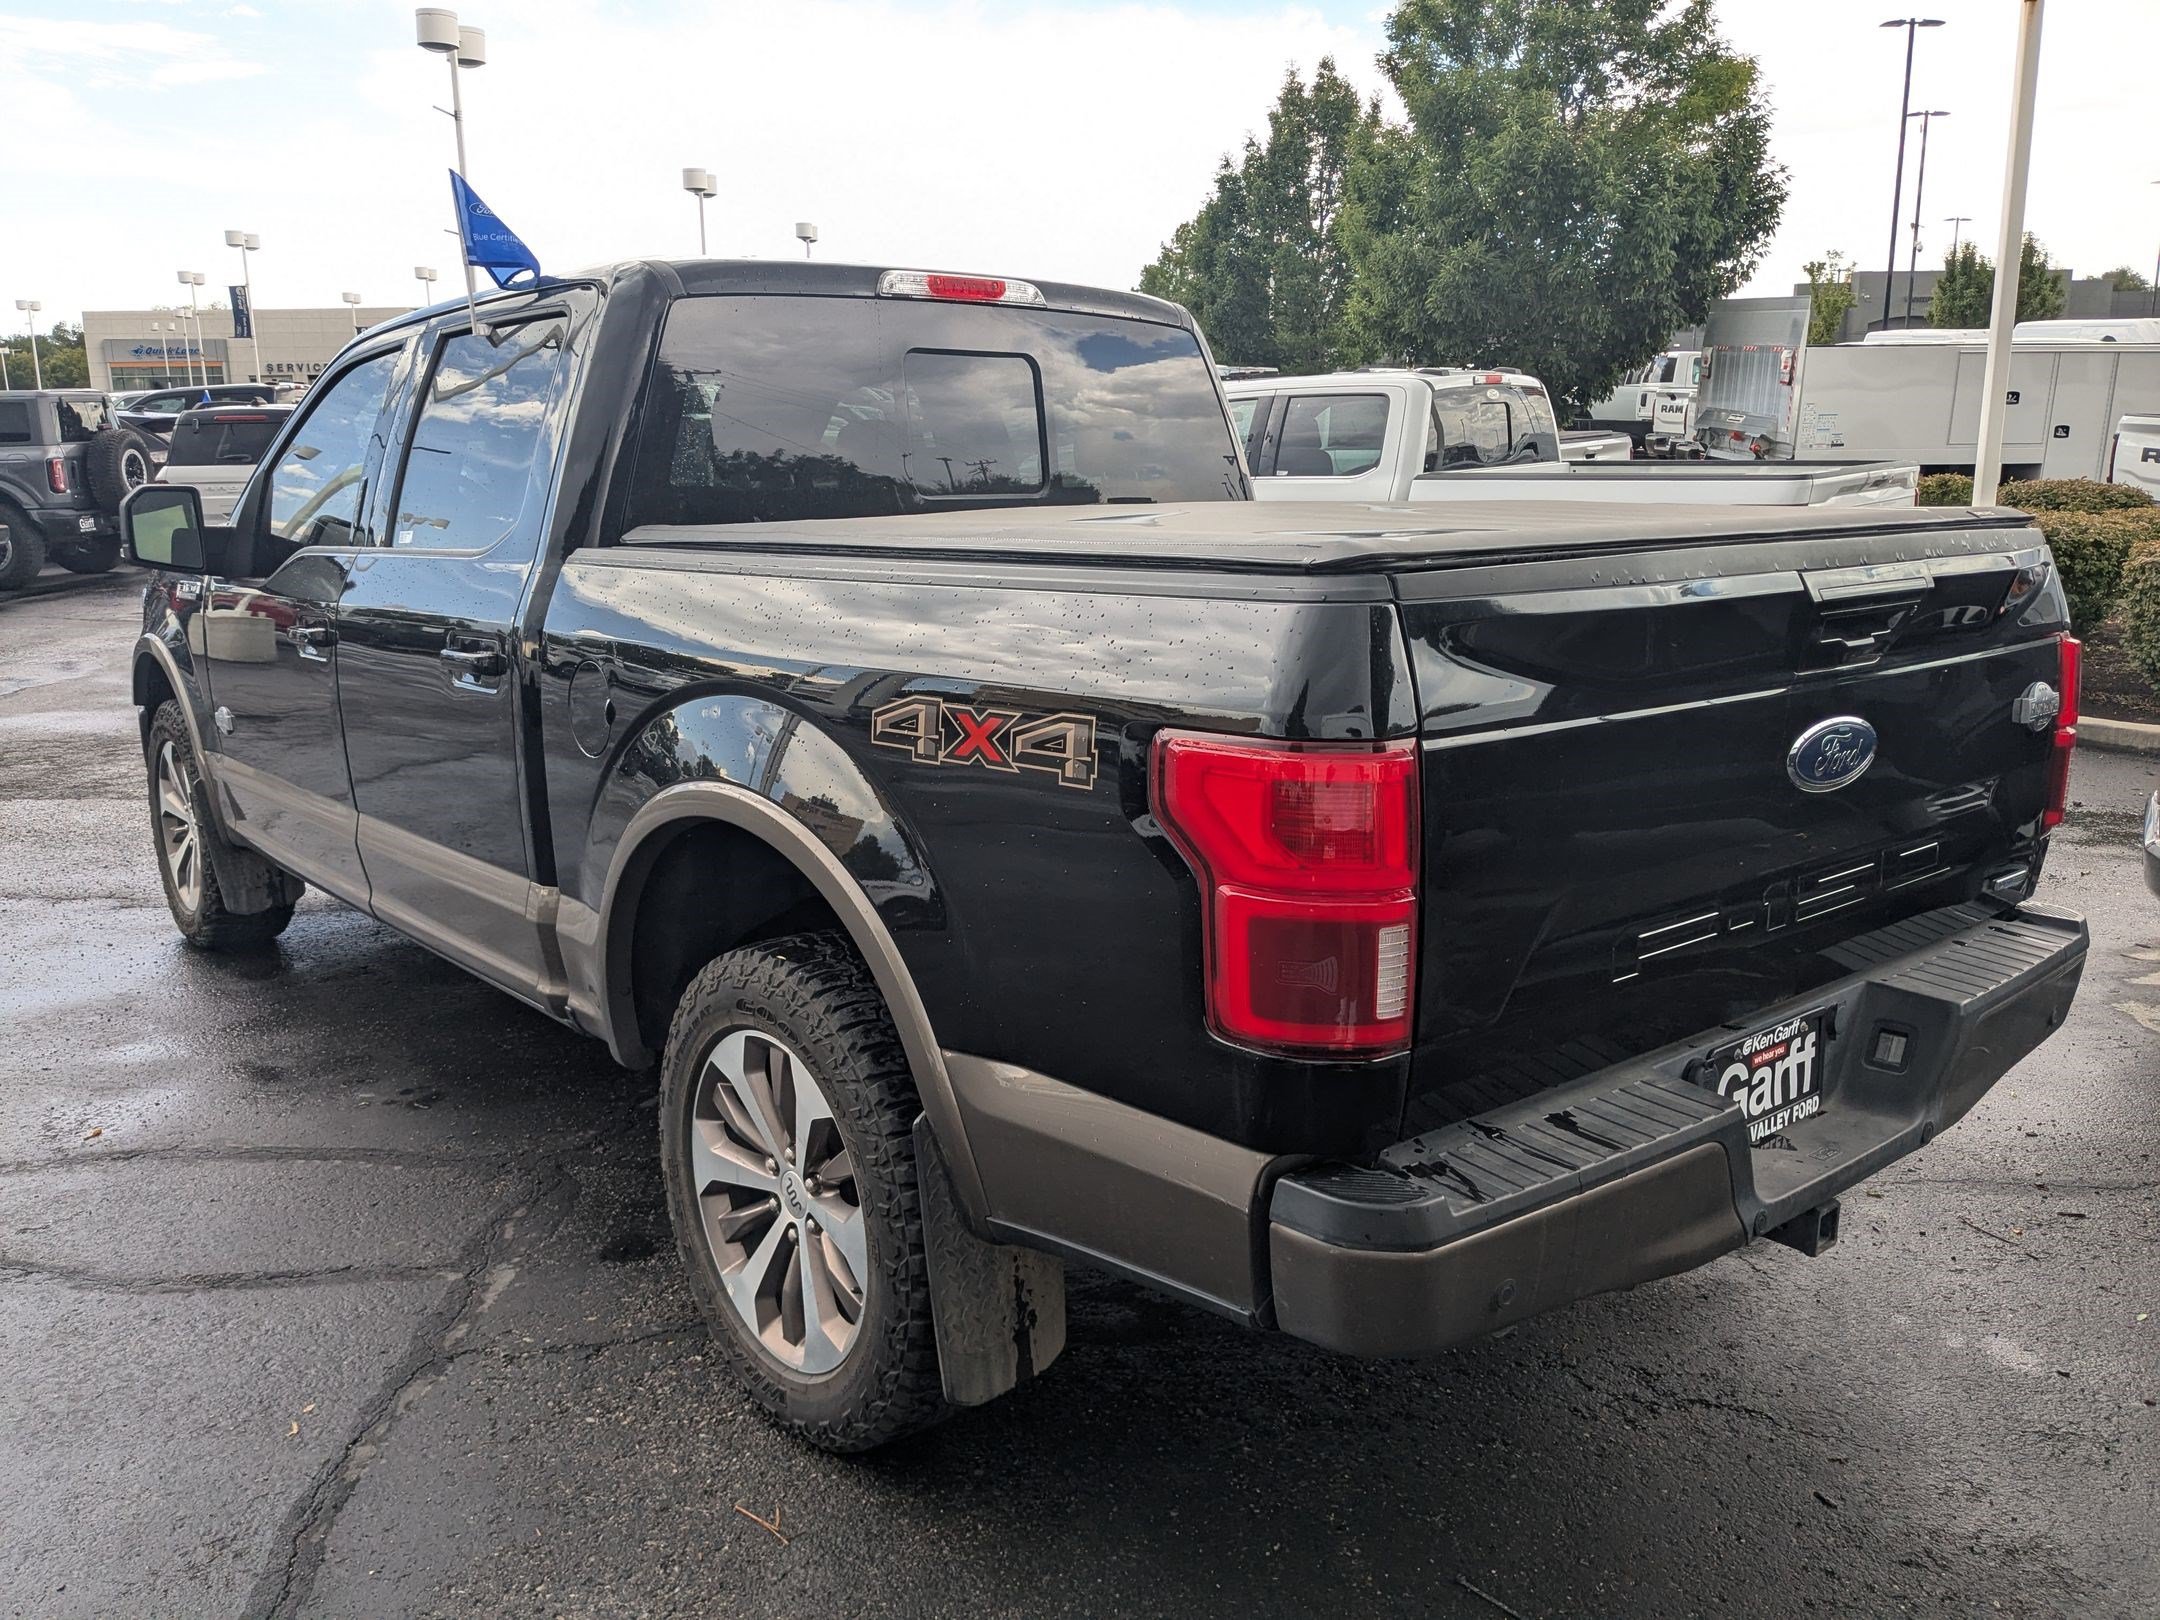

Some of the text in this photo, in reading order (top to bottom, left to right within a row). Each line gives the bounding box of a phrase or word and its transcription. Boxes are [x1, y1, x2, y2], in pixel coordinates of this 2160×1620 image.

[1660, 404, 1684, 414] RAM
[1814, 732, 1864, 776] Ford
[1751, 1018, 1801, 1052] Ken Garff
[1753, 1045, 1785, 1064] we hear you
[1717, 1031, 1816, 1119] Garff
[1750, 1095, 1820, 1142] VALLEY FORD
